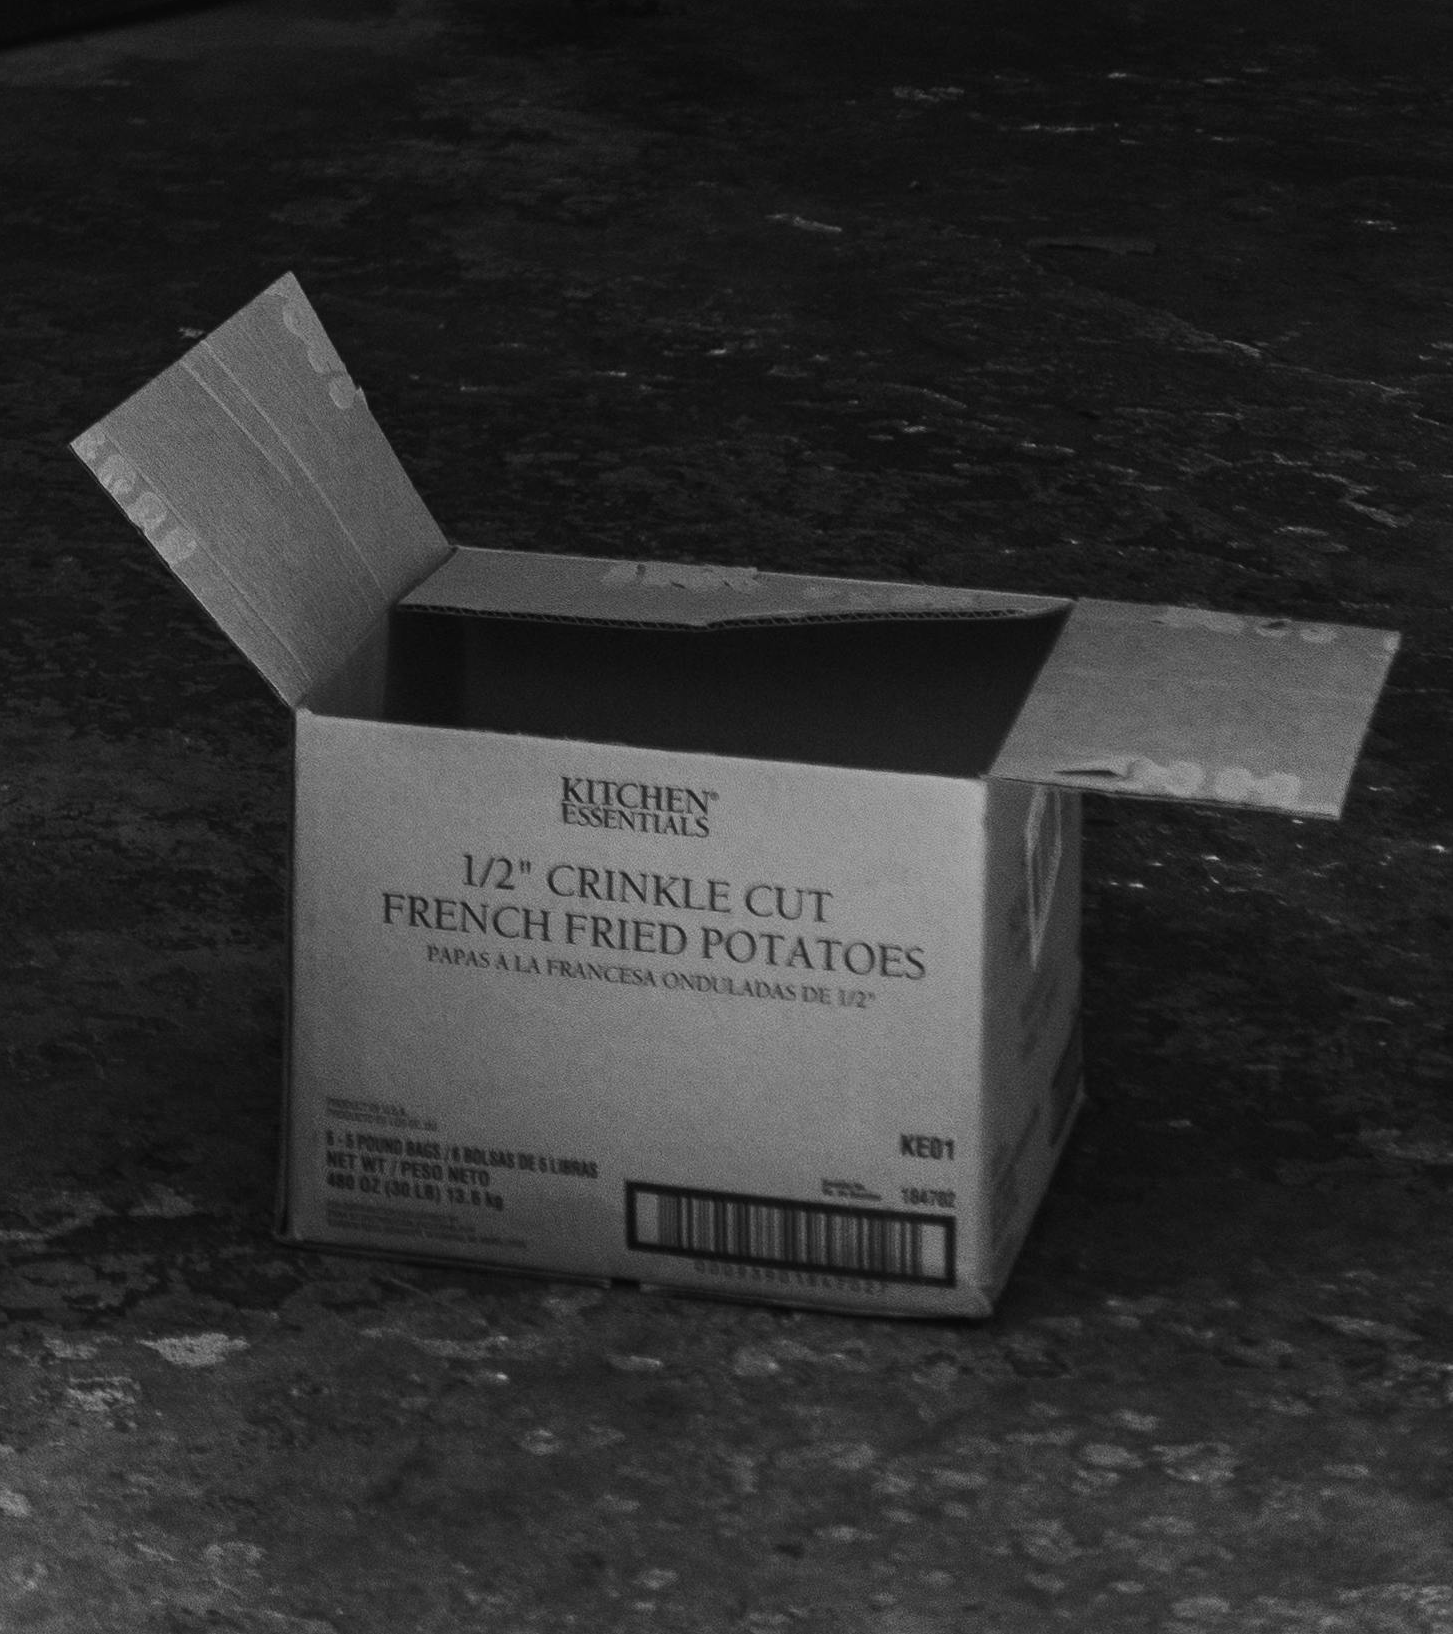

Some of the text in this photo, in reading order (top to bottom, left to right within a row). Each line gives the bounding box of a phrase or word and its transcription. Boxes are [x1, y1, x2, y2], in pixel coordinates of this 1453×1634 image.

[561, 802, 710, 838] ESSENTIALS
[462, 853, 834, 923] 1/2" CRINKLE CUT
[382, 892, 926, 980] FRENCH FRIED POTATOES
[427, 944, 490, 969] PAPAS
[495, 954, 509, 971] A
[514, 955, 542, 974] LA
[546, 958, 657, 986] FRANCESA
[662, 971, 797, 1001] ONDULADAS
[802, 985, 832, 1005] DE
[326, 1150, 357, 1171] NET
[361, 1155, 386, 1175] WT
[401, 1161, 443, 1181] PESO
[448, 1166, 490, 1187] NETO
[346, 1133, 355, 1149] 5
[357, 1133, 404, 1155] POUND
[407, 1139, 441, 1160] BAGS
[463, 1146, 515, 1170] BOLSAS
[519, 1152, 535, 1172] DE
[549, 1157, 598, 1179] LIBRAS
[900, 1133, 955, 1162] KE01
[326, 1171, 355, 1190] 480
[359, 1175, 381, 1194] OZ
[385, 1179, 411, 1198] (30
[414, 1183, 442, 1205] LB)
[485, 1190, 504, 1212] kg
